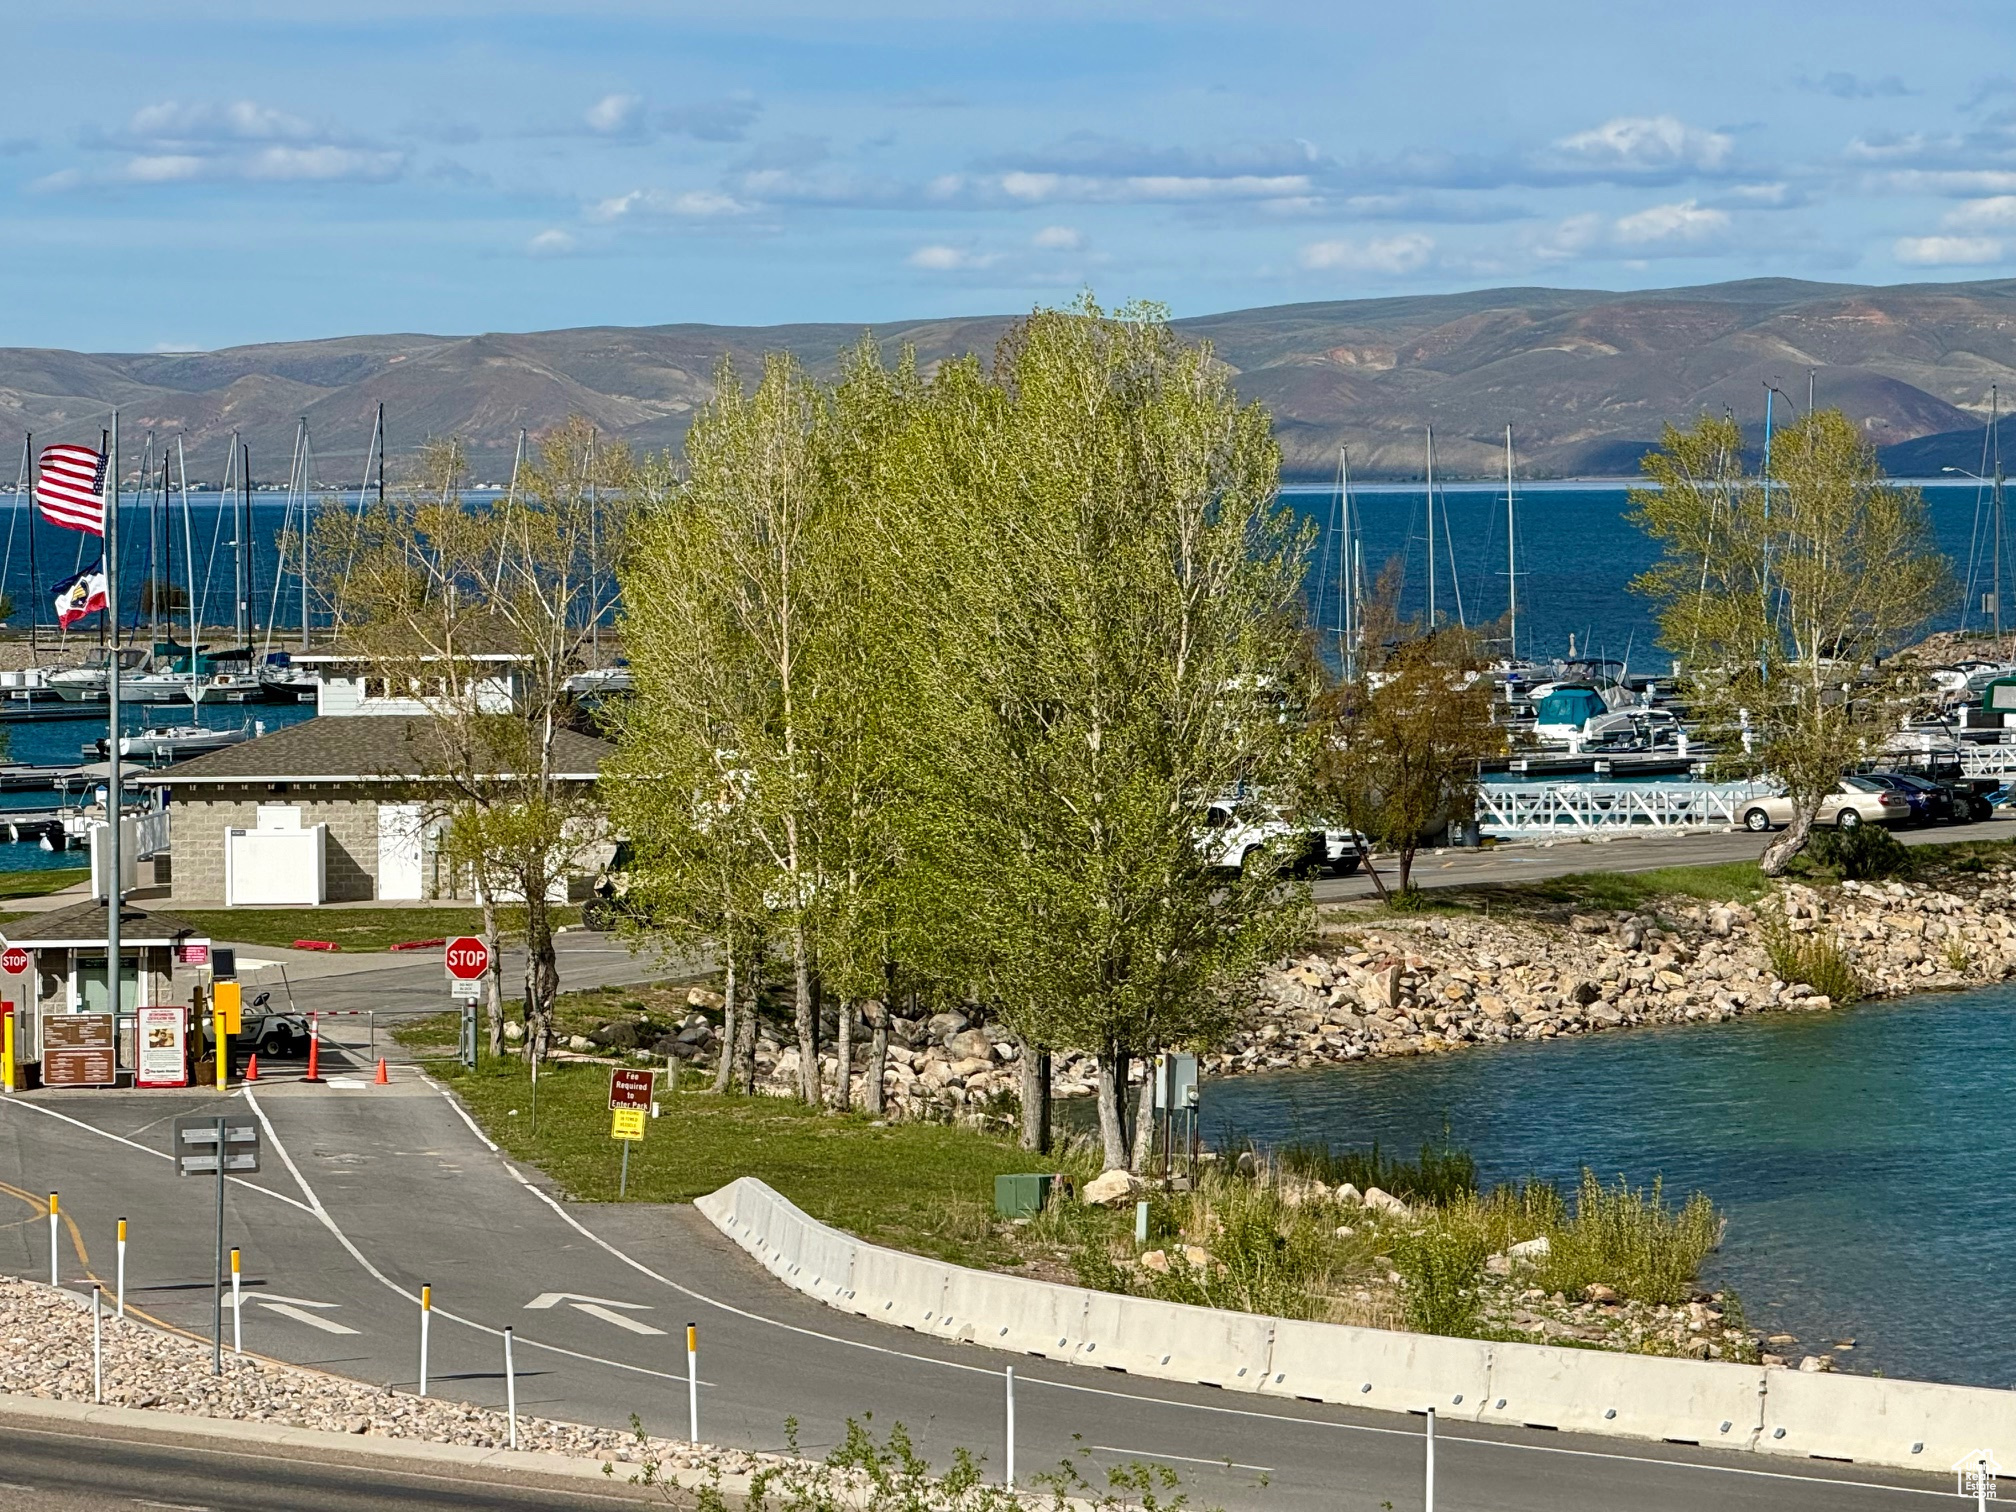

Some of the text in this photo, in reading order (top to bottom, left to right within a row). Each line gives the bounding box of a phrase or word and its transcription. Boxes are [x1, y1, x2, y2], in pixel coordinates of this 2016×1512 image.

[3, 956, 27, 966] STOP
[448, 950, 486, 966] STOP
[626, 1072, 639, 1080] Fee
[616, 1081, 647, 1090] Required
[632, 1101, 648, 1109] Park
